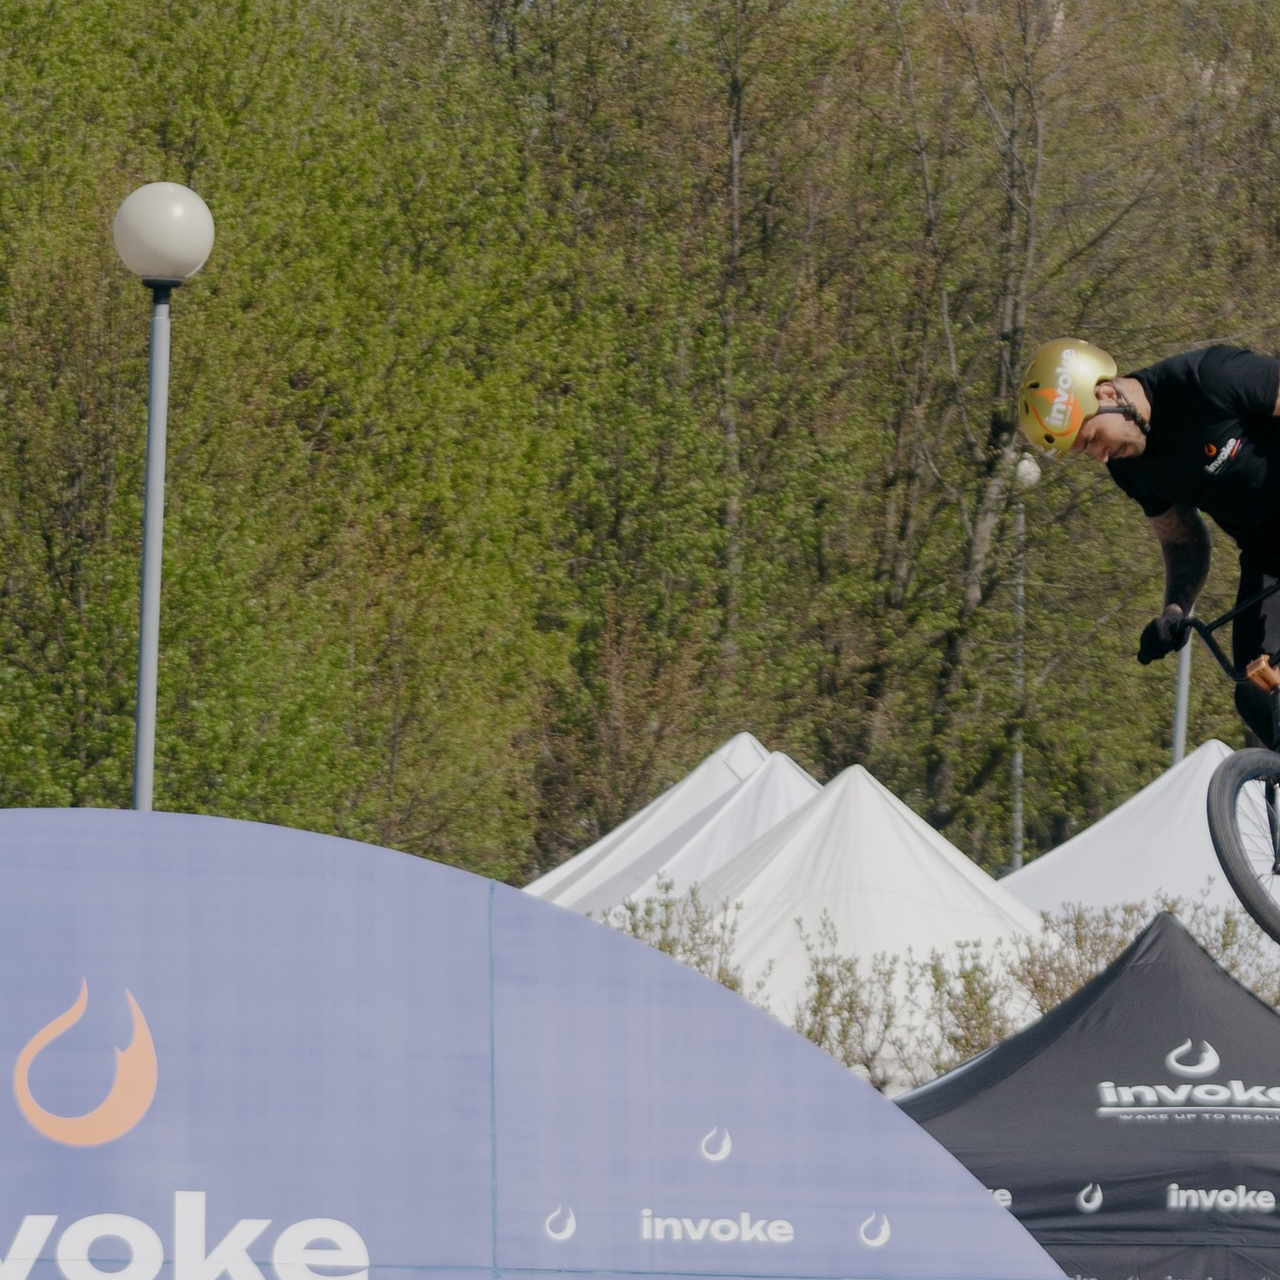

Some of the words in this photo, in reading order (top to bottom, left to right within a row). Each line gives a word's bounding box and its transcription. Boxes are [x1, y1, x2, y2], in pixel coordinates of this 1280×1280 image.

[1045, 349, 1077, 427] invoke
[1204, 438, 1237, 472] invoke
[1169, 1184, 1275, 1210] invoke
[642, 1209, 793, 1242] invoke
